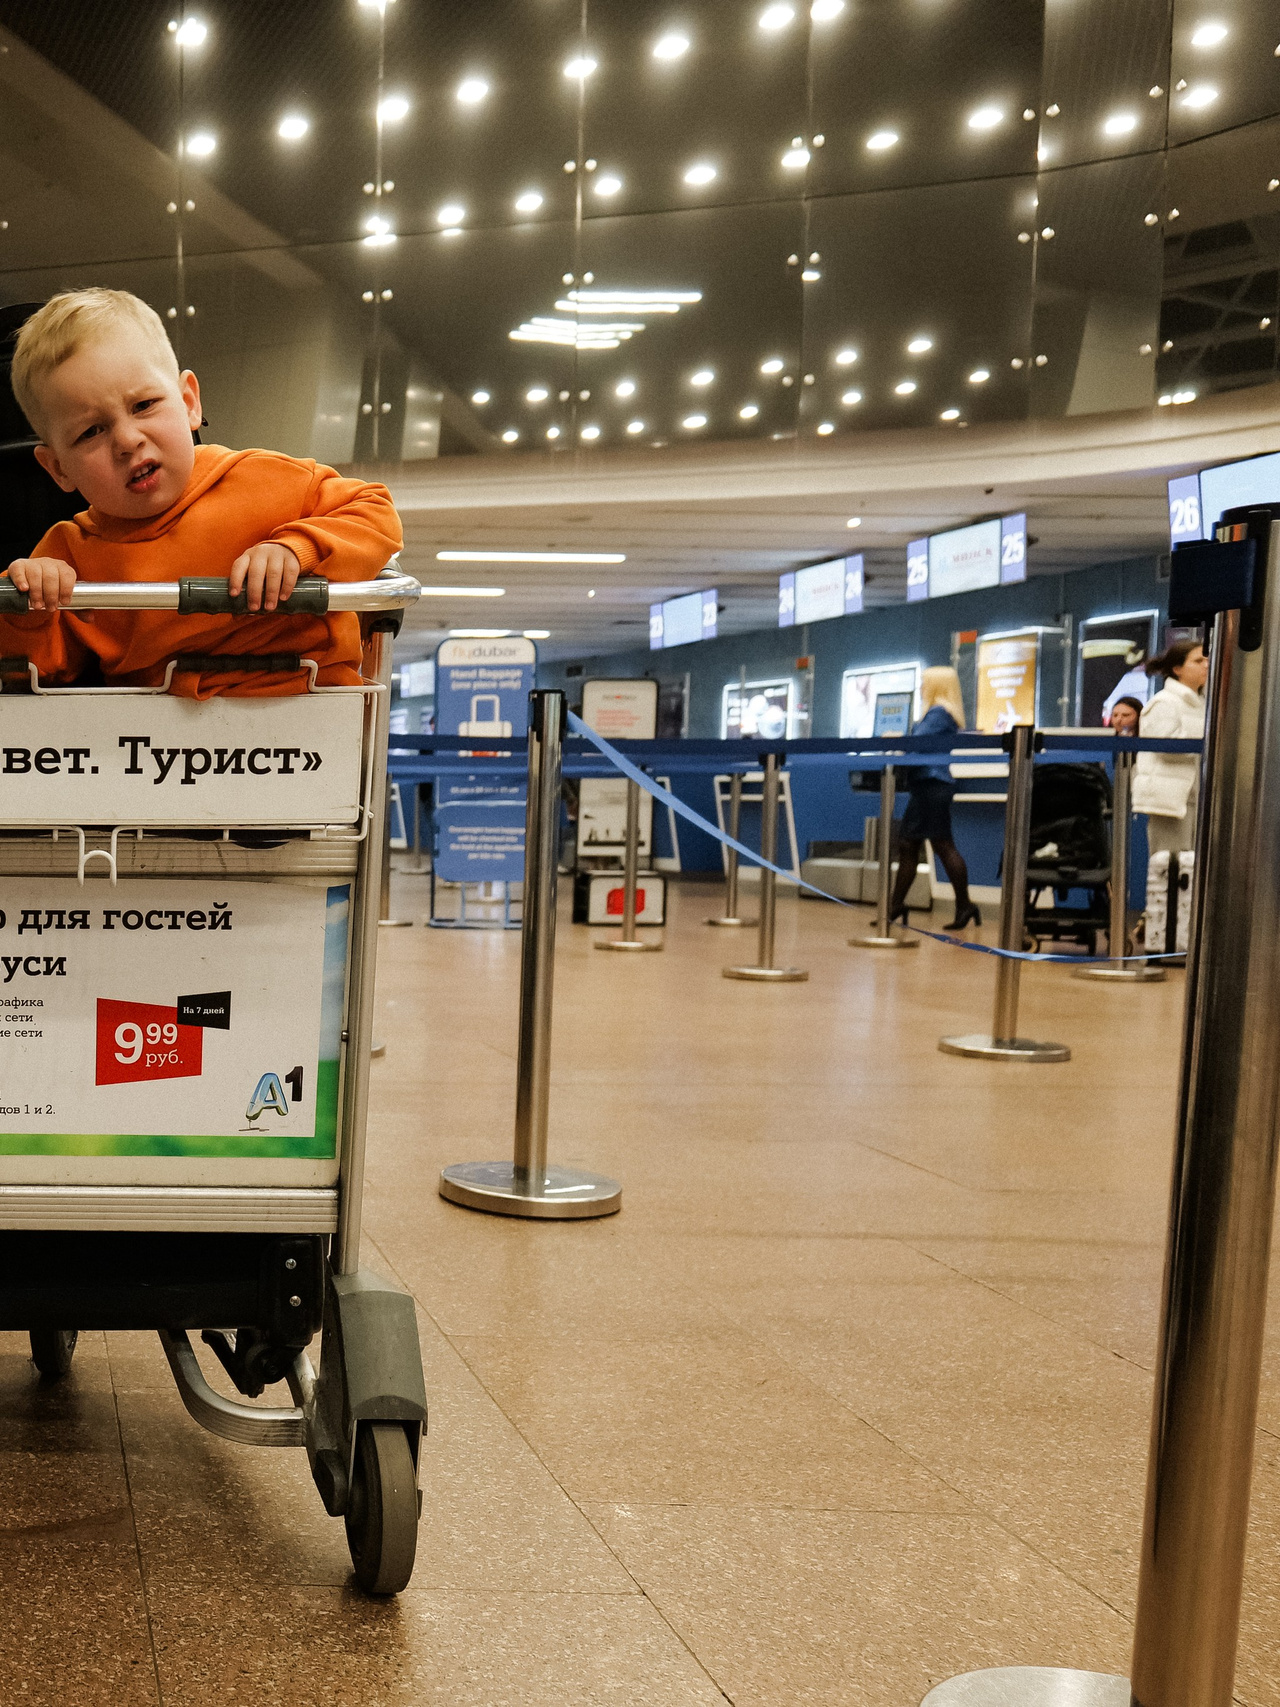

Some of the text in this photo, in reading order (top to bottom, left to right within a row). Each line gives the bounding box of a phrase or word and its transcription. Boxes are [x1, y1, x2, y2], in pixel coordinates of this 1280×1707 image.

[1170, 496, 1200, 534] 26
[1002, 531, 1025, 566] 25
[907, 554, 928, 586] 25
[118, 736, 323, 785] Турист»
[18, 910, 90, 935] для
[103, 902, 232, 930] гостей
[5, 1014, 33, 1022] сети
[202, 1007, 225, 1015] дней
[14, 1030, 43, 1038] сети
[114, 1022, 178, 1064] 9 99
[145, 1049, 184, 1067] руб.
[245, 1065, 304, 1120] A1
[24, 1104, 30, 1114] 1
[34, 1106, 42, 1114] и
[45, 1104, 56, 1114] 2.
